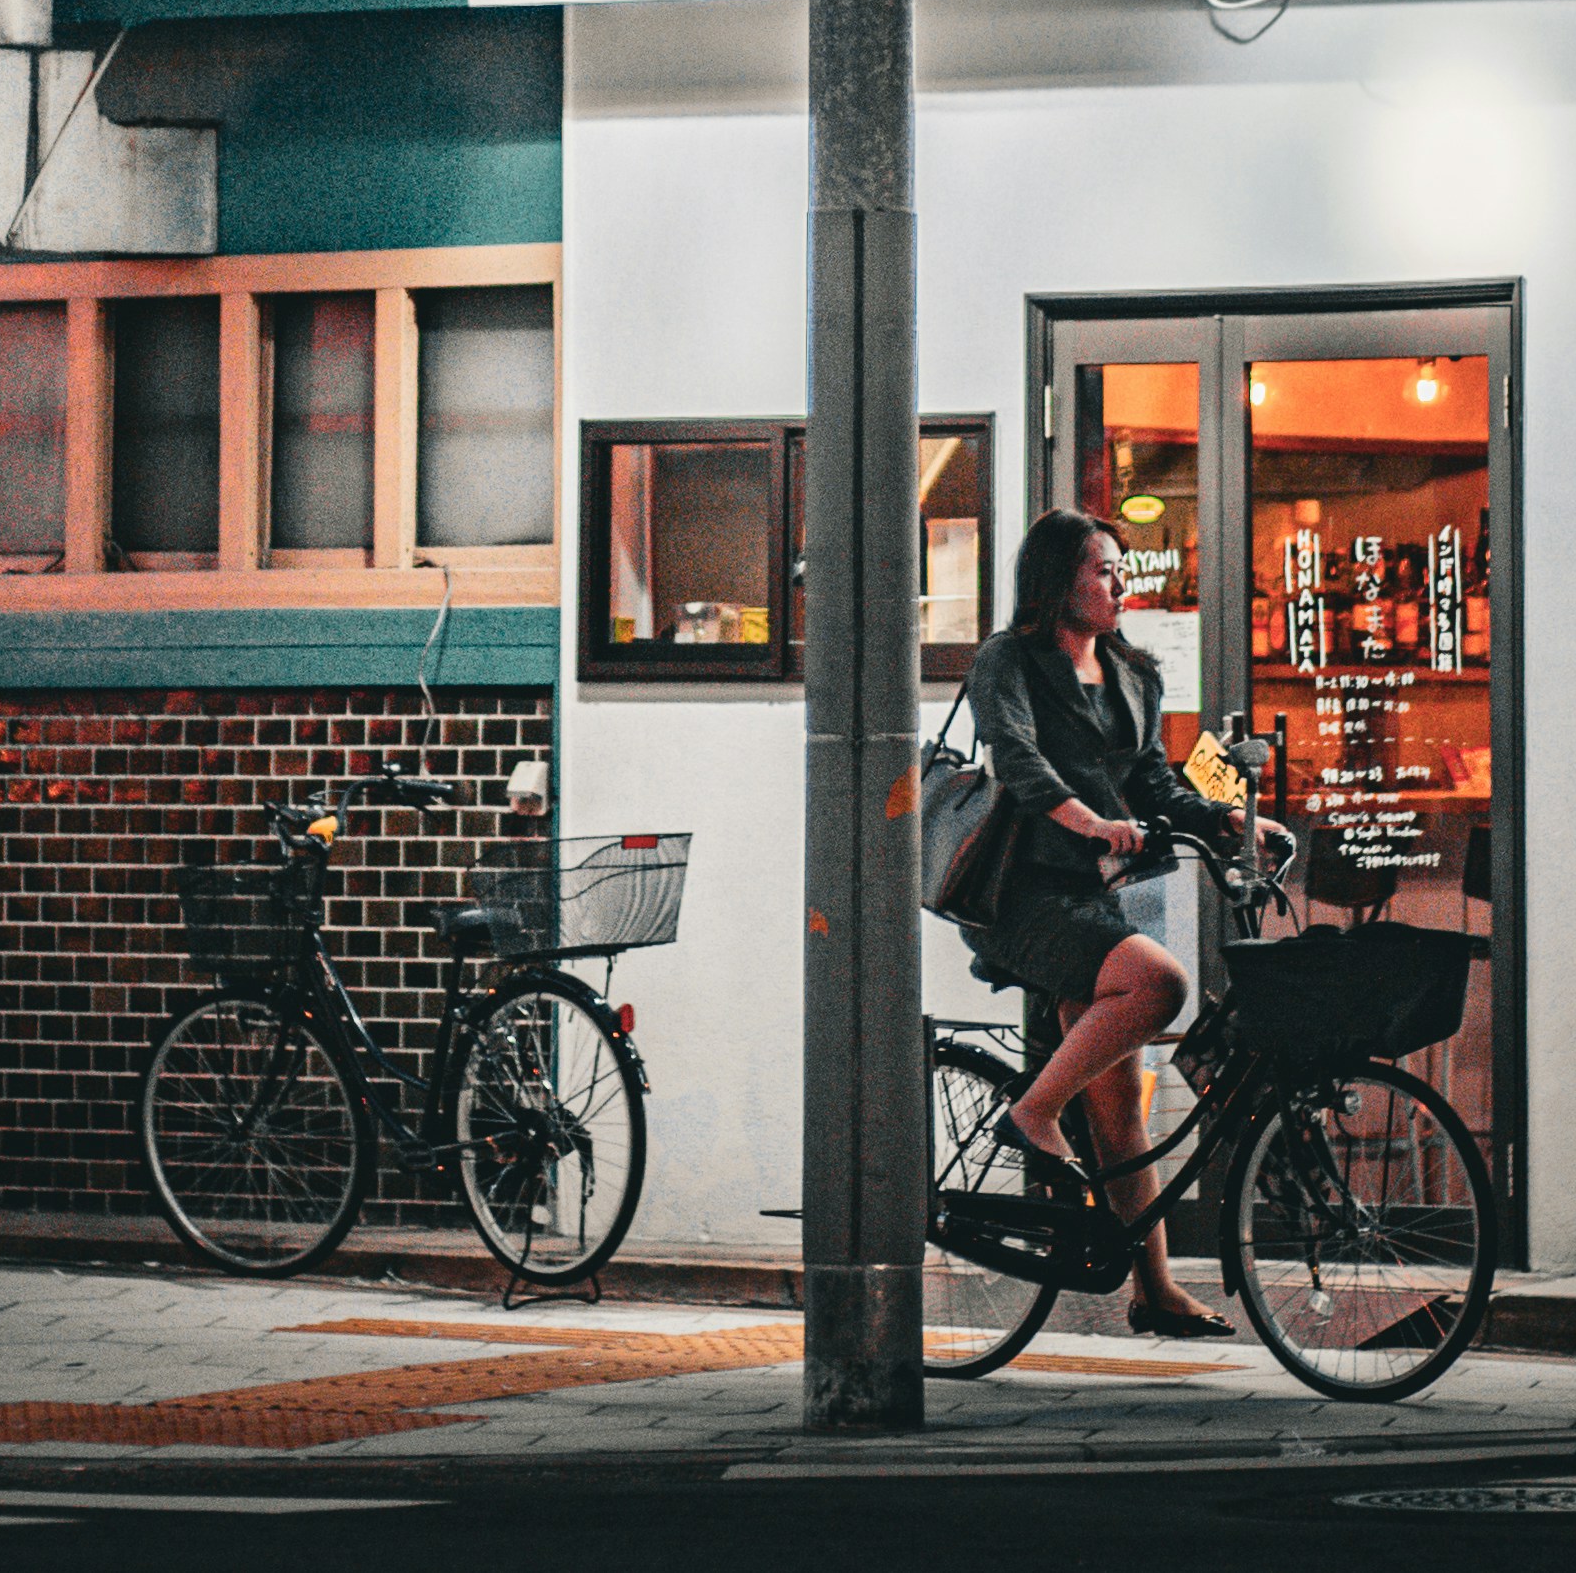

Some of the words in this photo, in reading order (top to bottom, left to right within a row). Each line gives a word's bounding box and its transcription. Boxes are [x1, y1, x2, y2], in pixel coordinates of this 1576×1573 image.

[1297, 528, 1315, 673] HONAMATA
[1355, 536, 1386, 659] ほなまた
